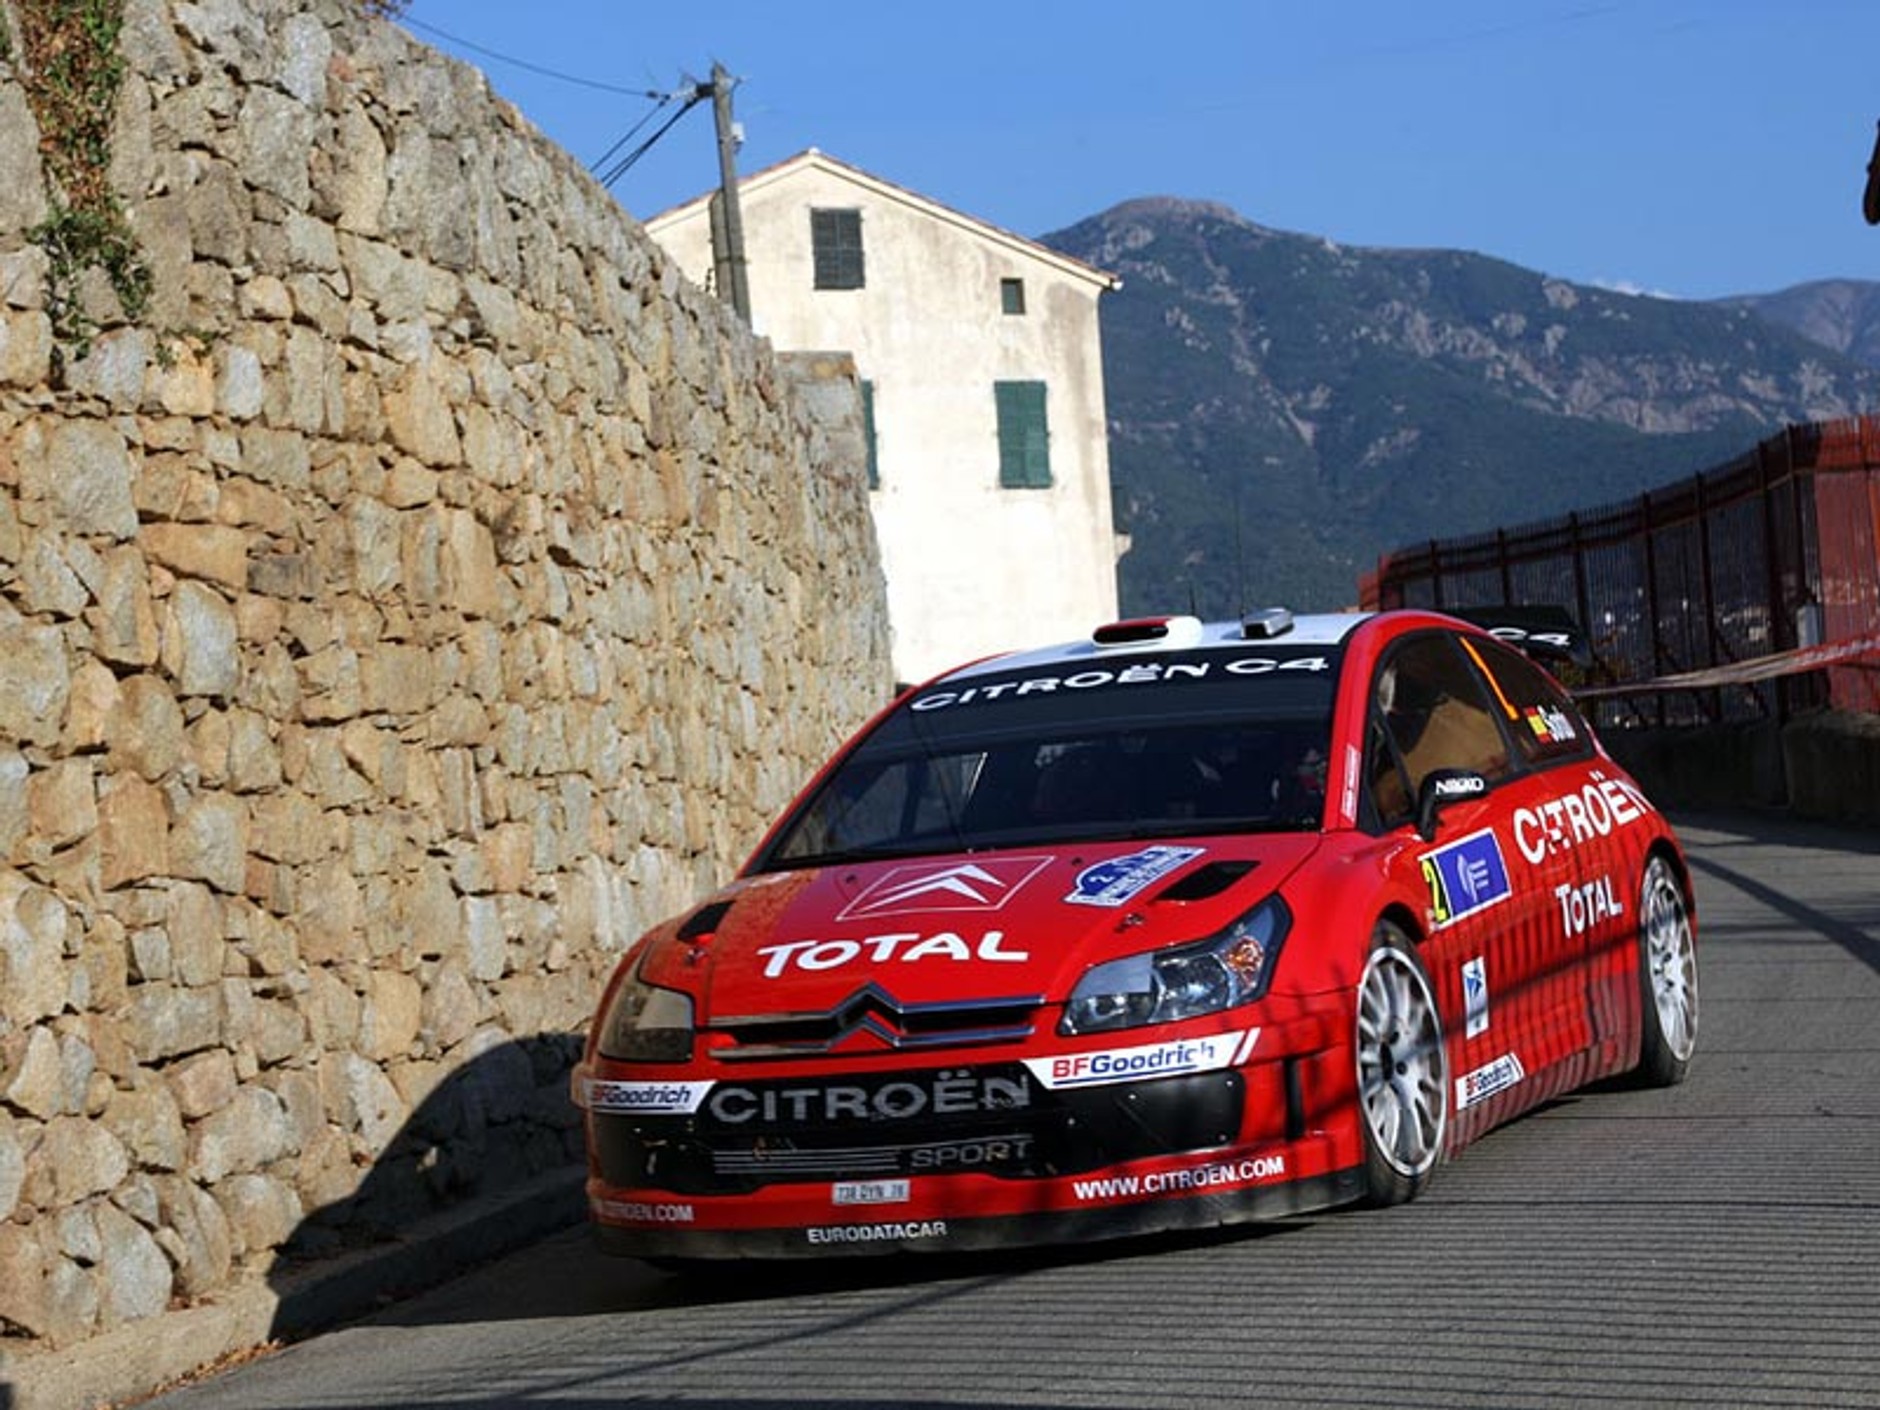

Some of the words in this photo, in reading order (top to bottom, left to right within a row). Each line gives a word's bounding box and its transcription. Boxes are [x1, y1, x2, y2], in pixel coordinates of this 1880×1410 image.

[1489, 627, 1570, 646] C4
[910, 662, 1209, 711] CITROËN
[1226, 657, 1330, 674] C4
[1422, 859, 1448, 922] 2
[1555, 875, 1623, 938] TOTAL
[758, 931, 1029, 978] TOTAL
[1052, 1042, 1216, 1079] BFGoodrich
[709, 1070, 1031, 1123] CITROËN
[911, 1139, 1034, 1168] SPORT
[807, 1222, 948, 1244] EURODATACAR
